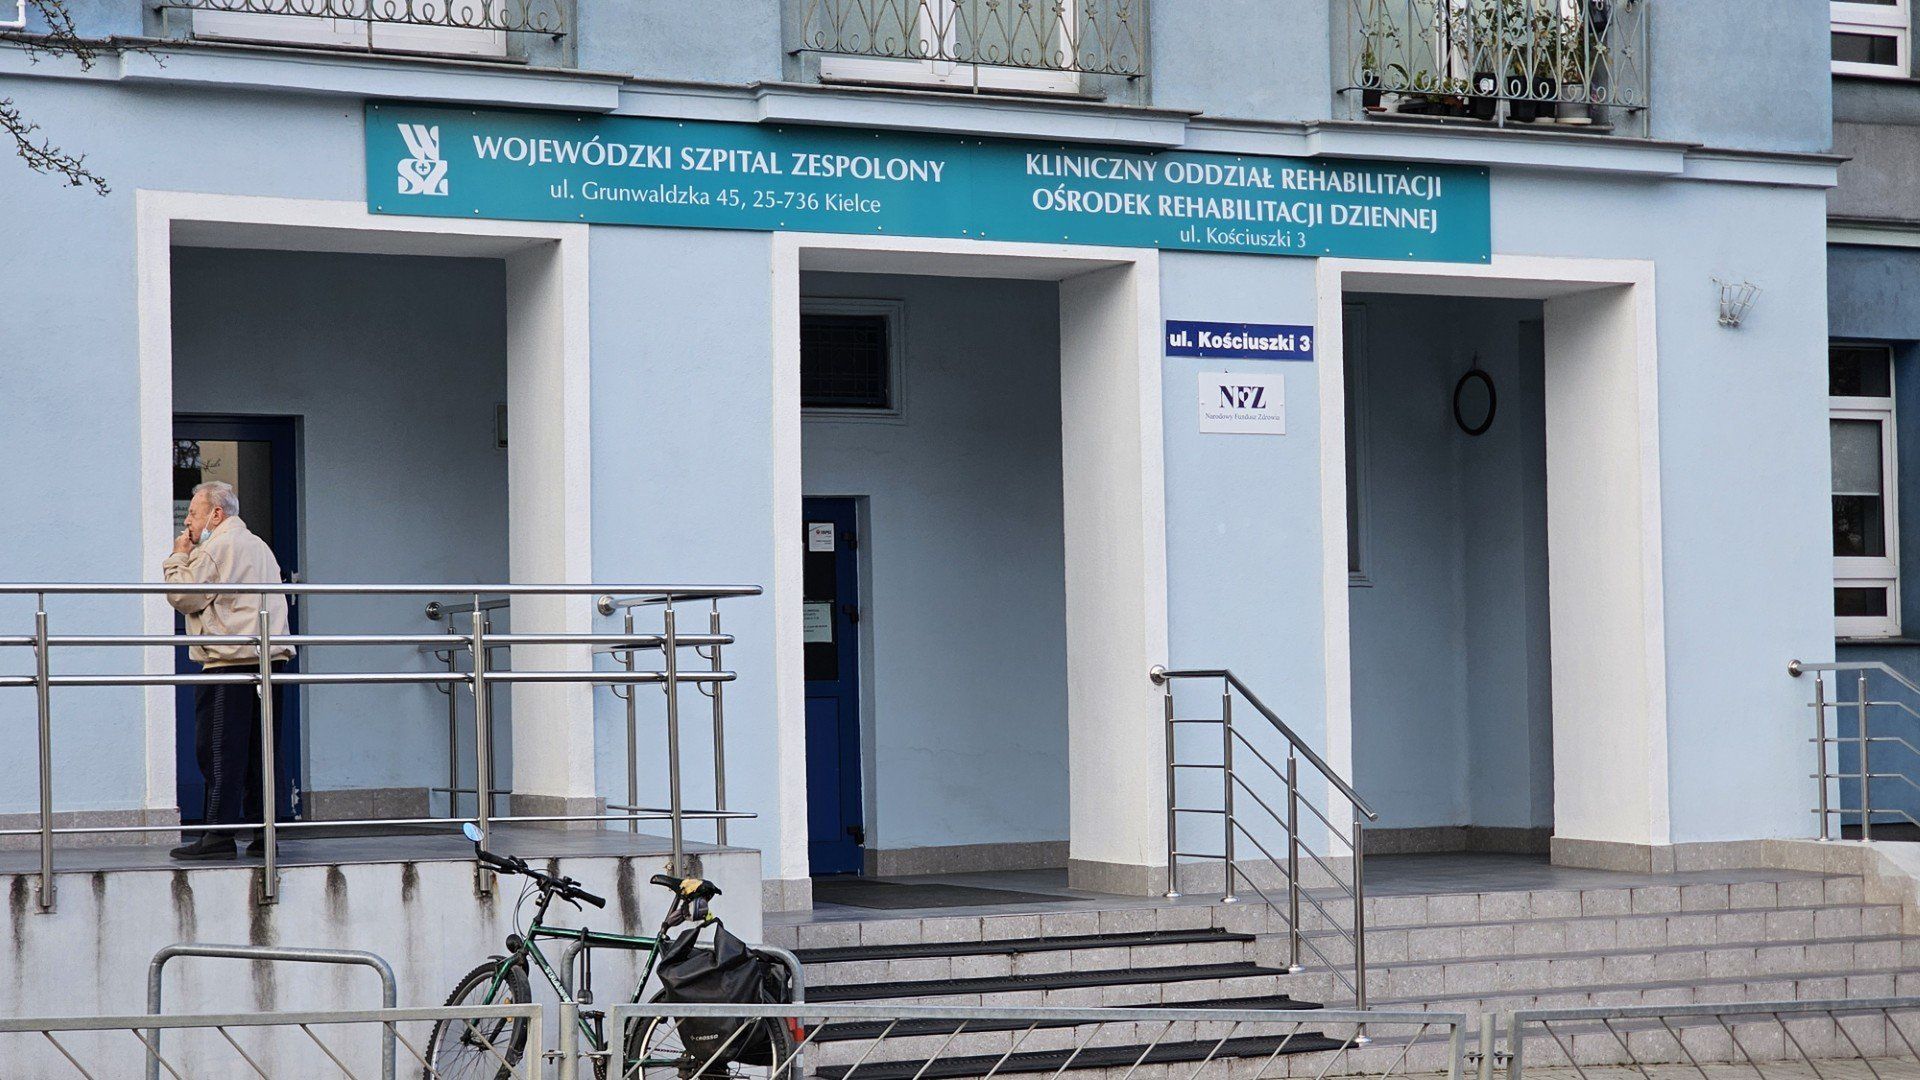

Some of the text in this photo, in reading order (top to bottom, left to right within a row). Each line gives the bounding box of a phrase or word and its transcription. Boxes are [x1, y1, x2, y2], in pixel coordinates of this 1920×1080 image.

[472, 135, 945, 183] WOJEWÓDZKI SZPITAL ZESPOLONY
[1026, 153, 1442, 200] KLINICZNY ODDZIAŁ REHABILITACJI
[550, 178, 882, 214] ul. Grunwaldzka 45, 25-736 Kielce
[1032, 183, 1437, 234] OŚRODEK REHABILITACJI DZIENNEJ
[1180, 224, 1307, 248] ul. Kościuszki 3
[1169, 331, 1311, 352] ul. Kościuszki 3
[1219, 384, 1267, 409] NFZ
